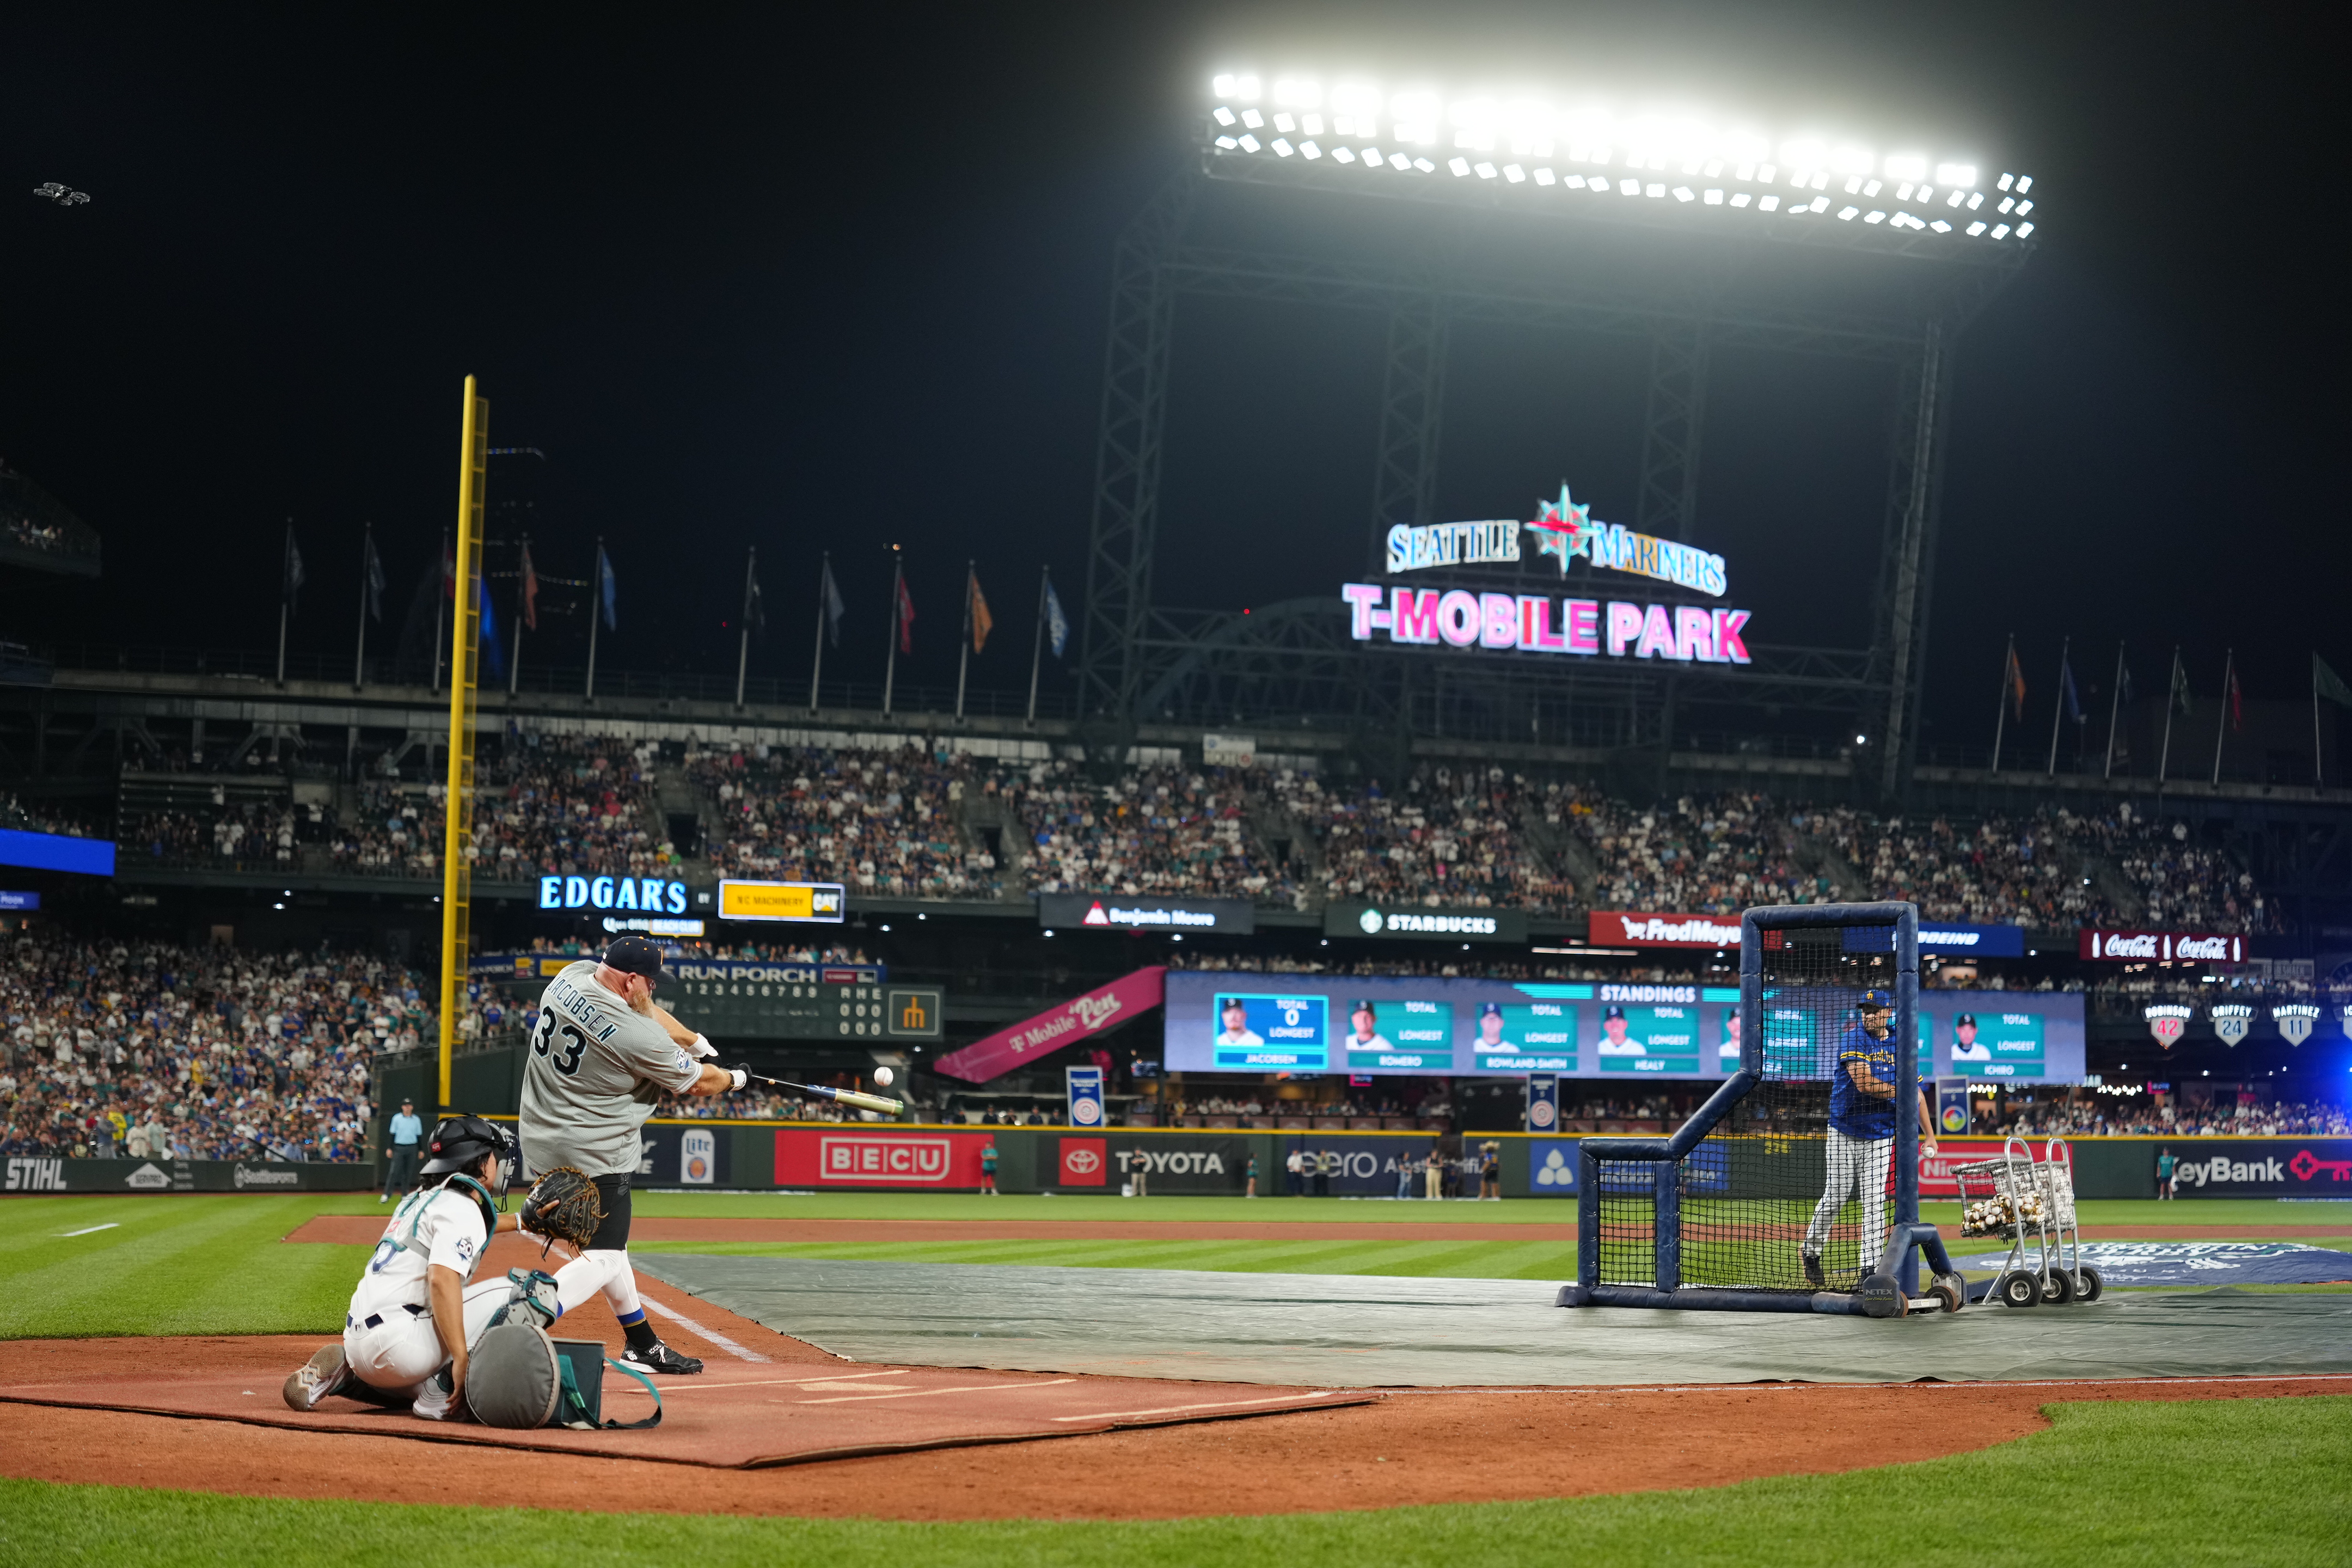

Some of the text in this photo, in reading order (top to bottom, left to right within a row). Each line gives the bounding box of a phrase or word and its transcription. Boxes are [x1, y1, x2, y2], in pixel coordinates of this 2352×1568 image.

[1387, 519, 1727, 597] SEATTLE MARINERS
[1342, 583, 1753, 664] T-MOBILE PARK
[540, 875, 687, 914] EDGAR'S
[753, 896, 804, 907] MACHINERY
[813, 893, 840, 912] CAT
[1109, 907, 1216, 927] Benjamin Moore
[1387, 914, 1497, 934] STARBUCKS
[1646, 918, 1741, 947] FredMeye
[679, 965, 727, 981] RUN
[731, 966, 817, 984] PORCH
[684, 982, 883, 1000] 1 2 3 4 5 6 7 8 9 R H E
[1600, 984, 1696, 1003] STANDINGS
[548, 976, 618, 1044] JACOBSEN
[840, 1002, 850, 1017] 0
[855, 1003, 866, 1018] 0
[871, 1003, 882, 1018] 0
[1276, 999, 1309, 1010] TOTAL
[1404, 1001, 1437, 1013] TOTAL
[1530, 1003, 1563, 1016] TOTAL
[1653, 1006, 1685, 1019] TOTAL
[2145, 1004, 2192, 1019] ROBINSON
[2212, 1004, 2253, 1018] GRIFFEY
[2273, 1004, 2320, 1018] MARTINEZ
[1284, 1008, 1300, 1026] 0
[2002, 1014, 2031, 1025] TOTAL
[839, 1021, 881, 1036] 0 0 0
[1024, 1016, 1077, 1048] Mobile
[1269, 1026, 1316, 1038] LONGEST
[1398, 1029, 1444, 1041] LONGEST
[2157, 1020, 2178, 1037] 42
[2222, 1020, 2243, 1036] 24
[2289, 1020, 2303, 1036] 11
[534, 1004, 588, 1077] 33
[1525, 1032, 1569, 1044] LONGEST
[1647, 1034, 1690, 1046] LONGEST
[1997, 1040, 2036, 1051] LONGEST
[1245, 1053, 1298, 1064] JACOBSEN
[1379, 1055, 1423, 1067] ROMERO
[1634, 1059, 1666, 1071] HEALY
[1984, 1064, 2015, 1076] ICHIRO
[686, 1137, 710, 1155] Lite
[831, 1147, 940, 1171] BECU
[5, 1157, 67, 1190] STIHL
